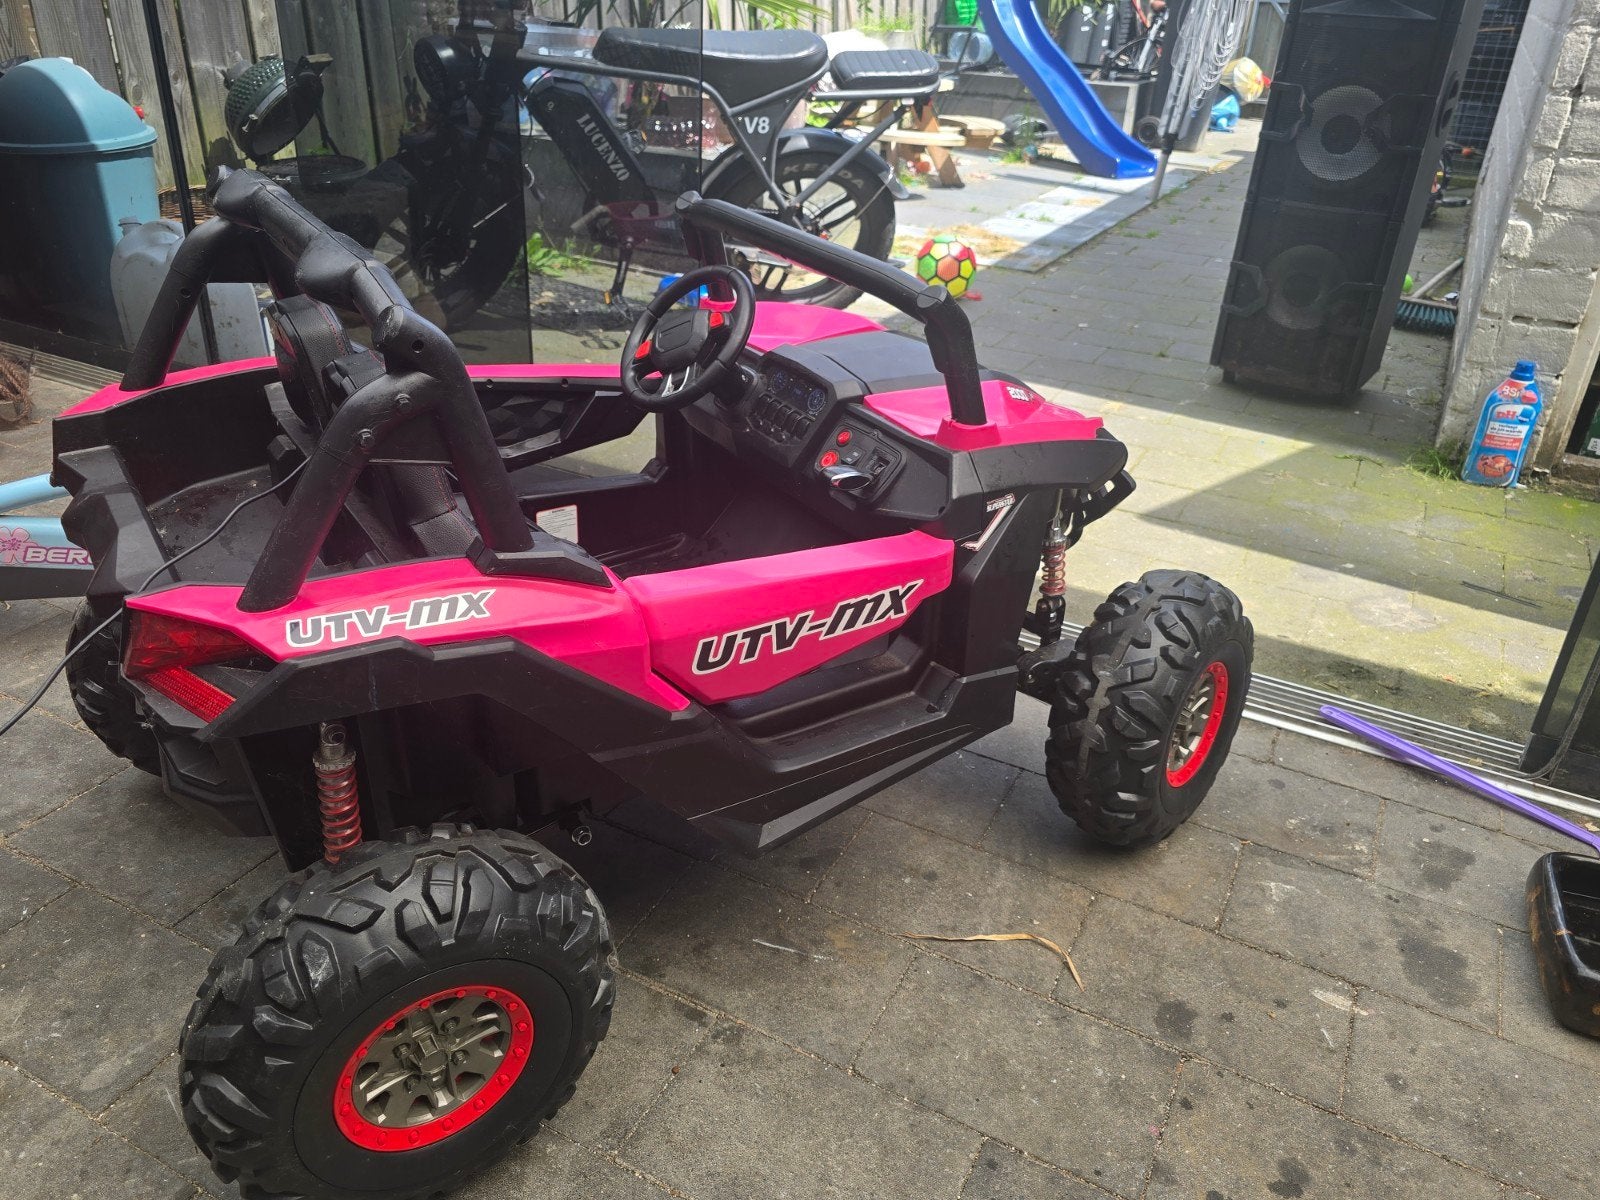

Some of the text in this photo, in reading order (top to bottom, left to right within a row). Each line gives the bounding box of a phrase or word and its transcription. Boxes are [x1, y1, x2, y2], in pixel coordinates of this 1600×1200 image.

[744, 116, 770, 134] V8
[576, 113, 630, 181] LUCENZO
[23, 546, 93, 565] BER
